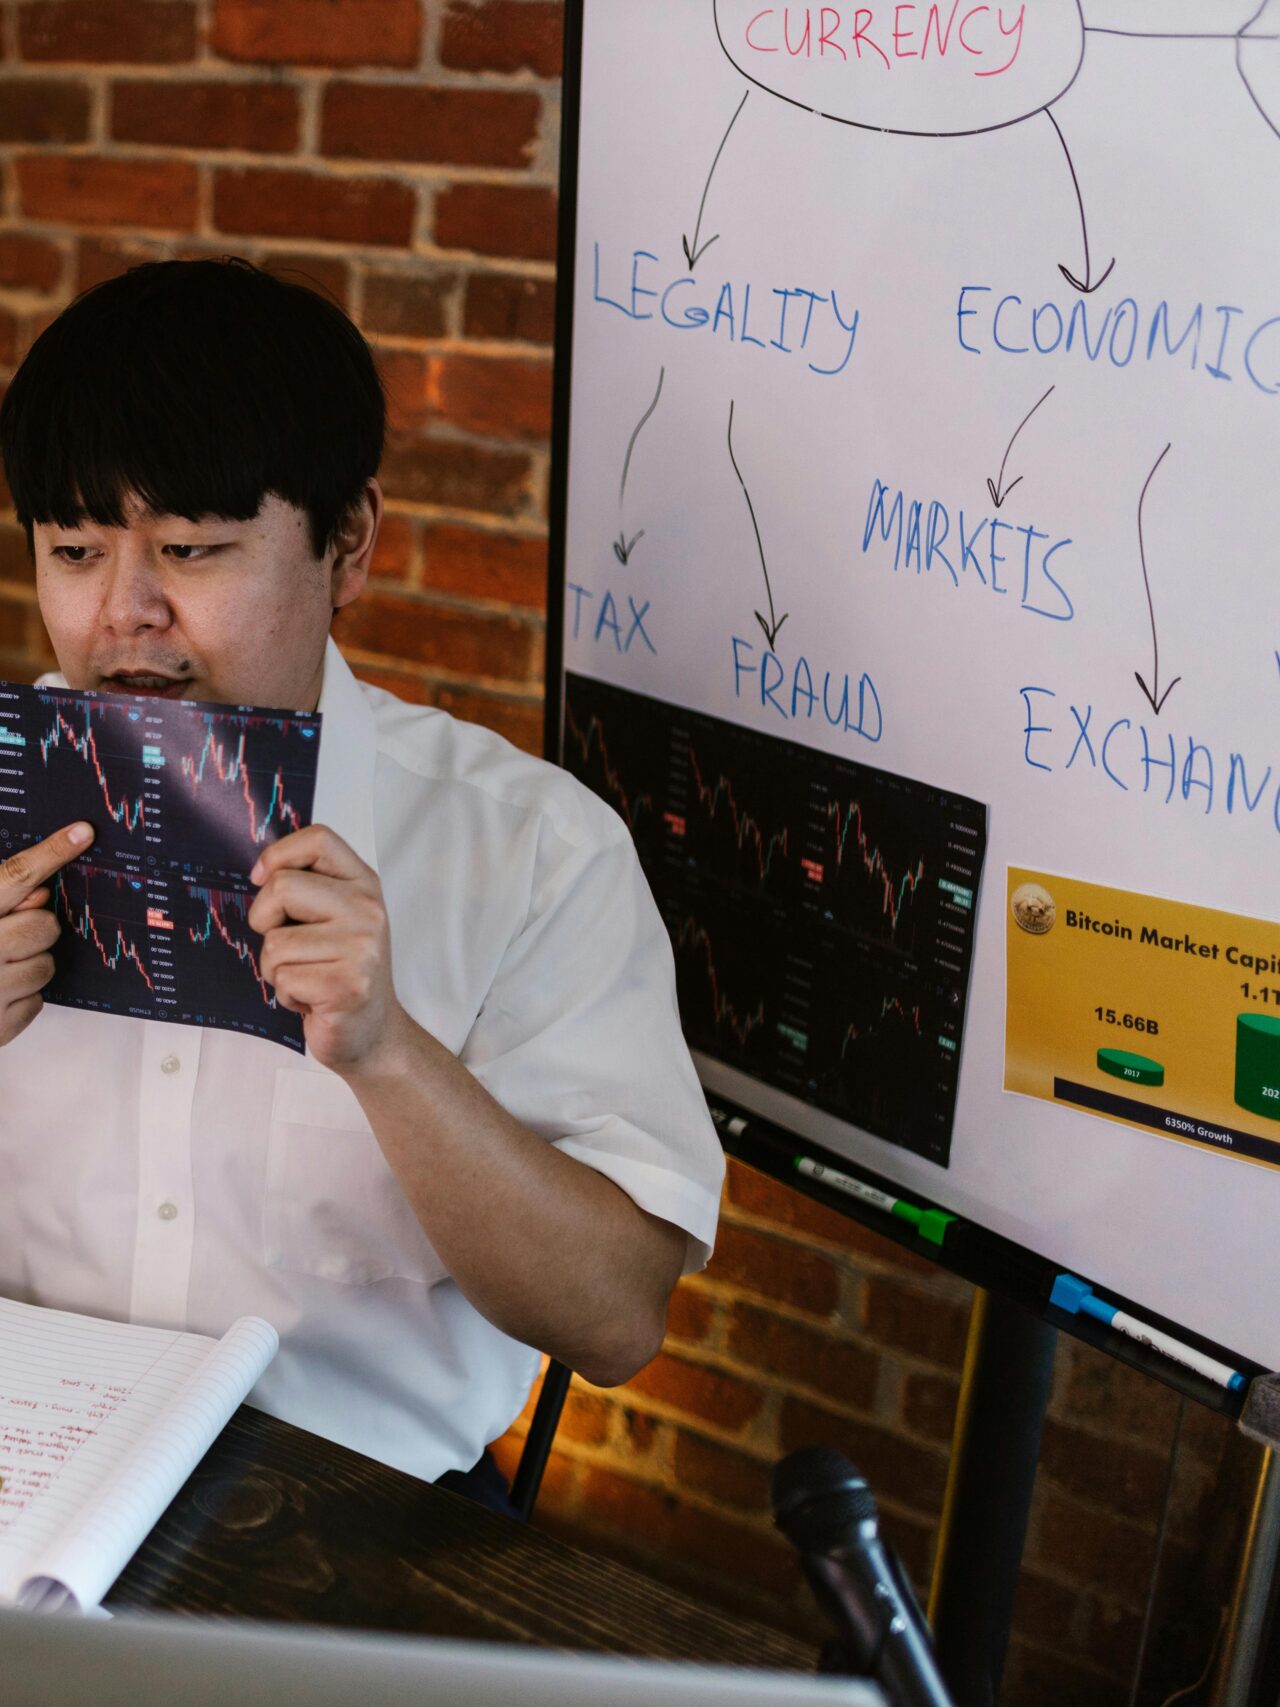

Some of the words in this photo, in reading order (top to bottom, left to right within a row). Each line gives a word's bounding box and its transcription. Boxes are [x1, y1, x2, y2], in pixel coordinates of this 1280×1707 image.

[746, 0, 1025, 76] CURRENCY
[594, 243, 859, 375] LEGALITY
[862, 478, 1073, 622] MARKETS
[568, 583, 657, 655] TAX
[731, 636, 883, 742] FRAUD
[1021, 687, 1280, 834] EXCHAN
[1066, 910, 1132, 940] Bitcoin
[1139, 927, 1220, 960] Market
[1094, 1006, 1160, 1036] 15.66B
[1123, 1067, 1141, 1079] 2017
[1165, 1116, 1196, 1134] 6350%
[1197, 1125, 1233, 1145] Growth
